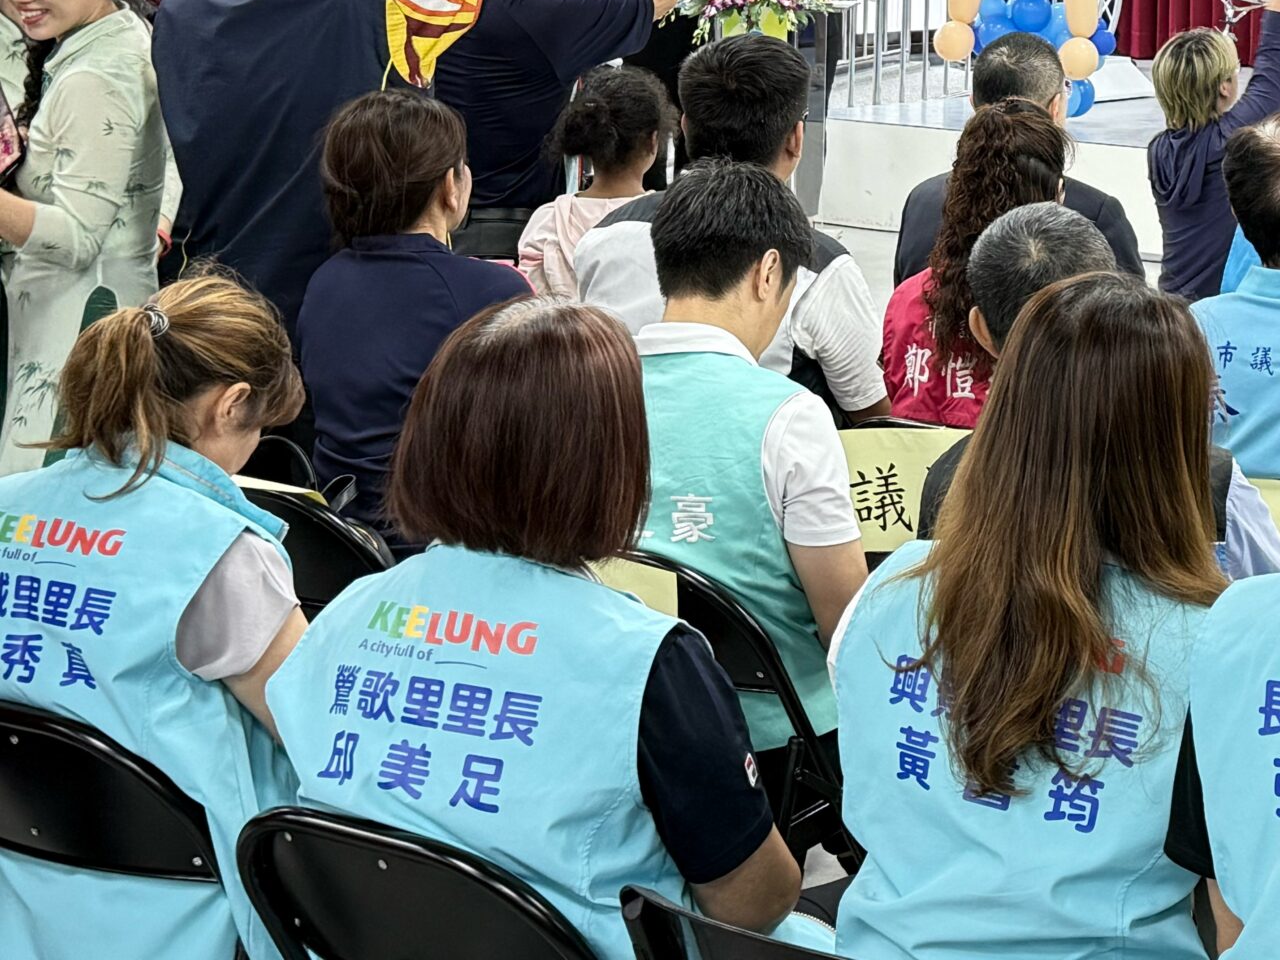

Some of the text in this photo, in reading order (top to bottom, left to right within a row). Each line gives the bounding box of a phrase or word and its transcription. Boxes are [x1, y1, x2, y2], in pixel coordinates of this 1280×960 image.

[904, 343, 998, 400] 鄭愷
[849, 463, 932, 533] 議
[2, 546, 38, 562] full of
[358, 638, 434, 662] A city full of
[367, 600, 540, 656] KEELUNG
[329, 663, 543, 747] 鶯歌里里長
[316, 729, 505, 815] 邱美足
